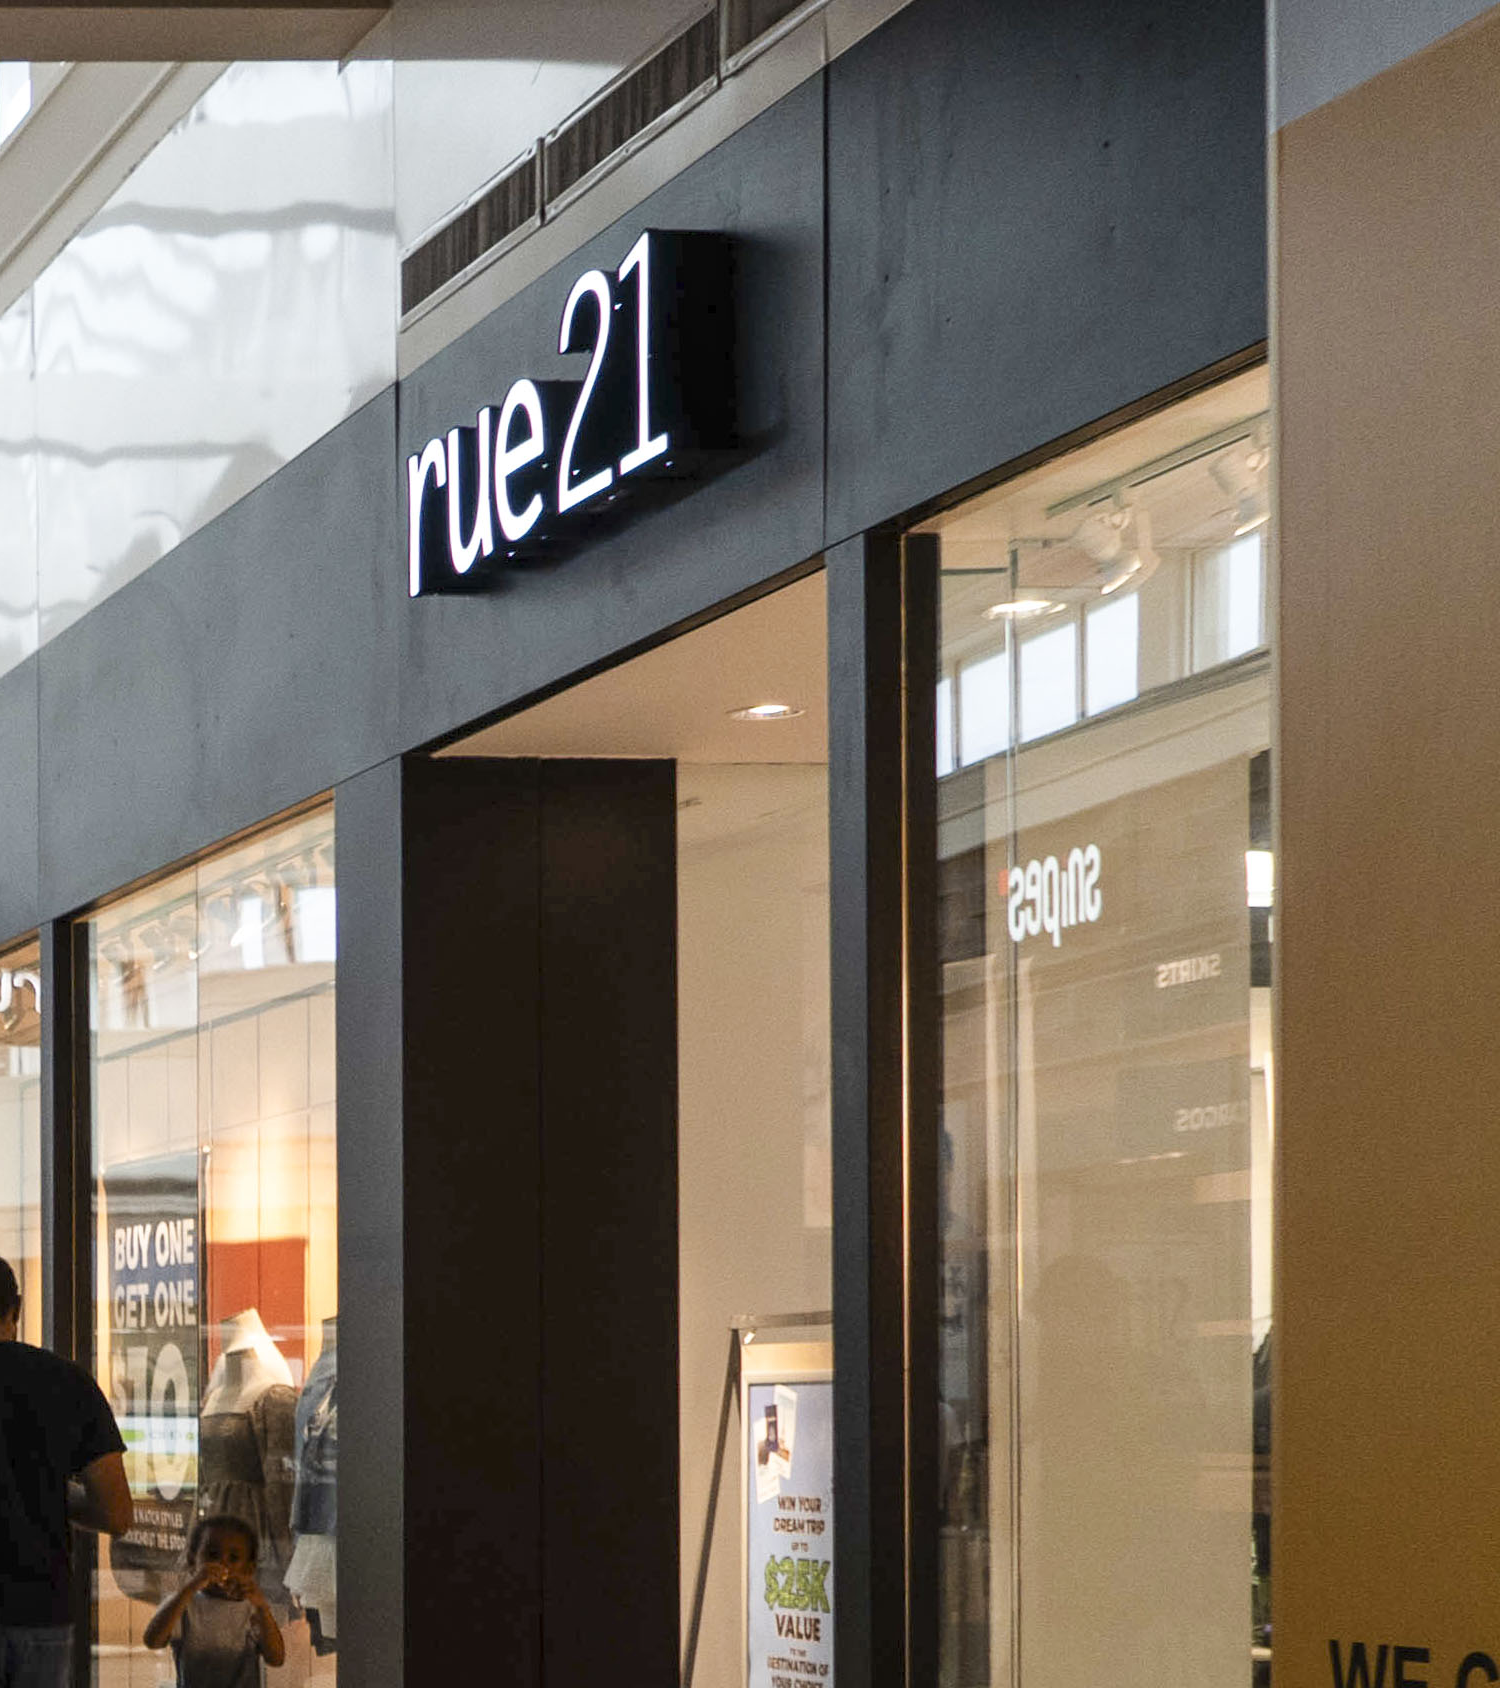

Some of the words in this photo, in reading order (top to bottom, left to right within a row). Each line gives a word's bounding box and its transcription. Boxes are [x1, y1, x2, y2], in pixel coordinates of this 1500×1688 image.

[406, 231, 668, 598] rue21
[114, 1223, 152, 1270] BUY
[155, 1218, 195, 1267] ONE
[114, 1283, 149, 1329] GET
[154, 1279, 197, 1328] ONE
[773, 1518, 804, 1534] DREAM
[806, 1520, 825, 1537] TRIP
[778, 1496, 796, 1511] WIN
[798, 1496, 822, 1513] YOUR
[764, 1554, 831, 1613] $25K
[775, 1613, 821, 1642] VALUE
